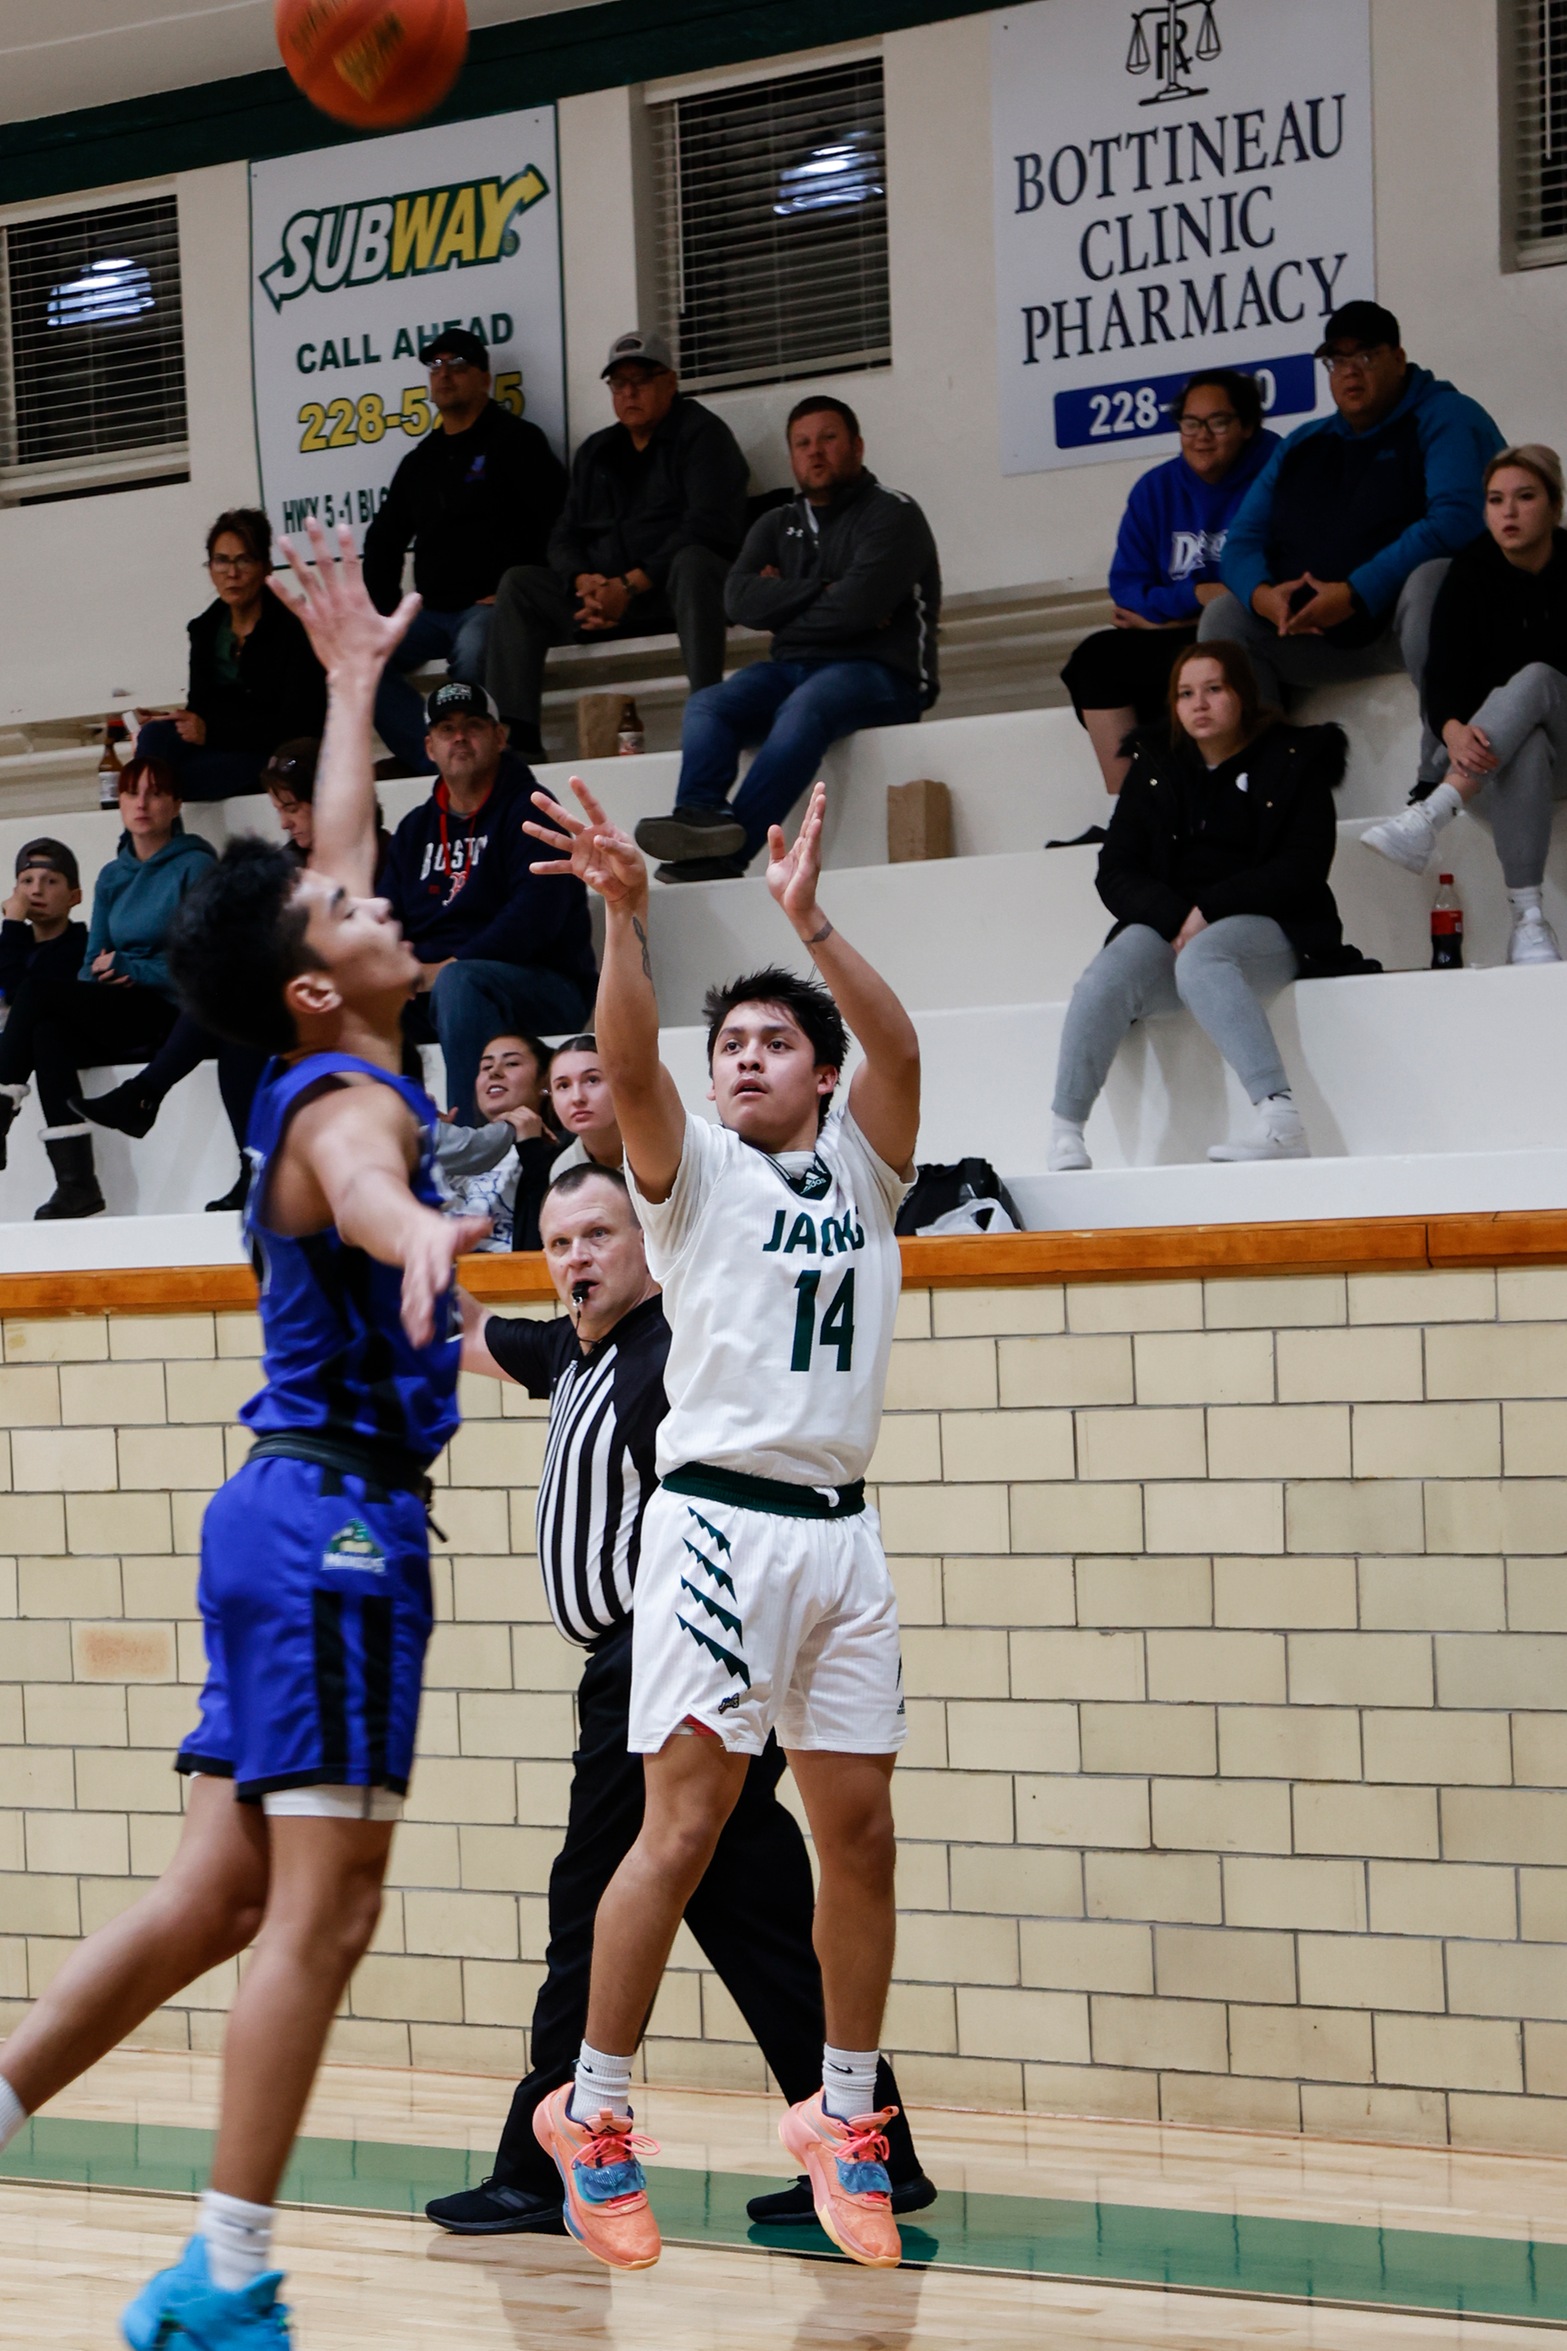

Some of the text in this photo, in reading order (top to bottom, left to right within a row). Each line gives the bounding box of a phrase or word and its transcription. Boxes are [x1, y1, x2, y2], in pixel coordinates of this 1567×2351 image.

[1013, 93, 1346, 214] BOTTINEAU
[259, 163, 550, 314] SUBWAY
[1079, 186, 1275, 282] CLINIC
[296, 312, 514, 374] CALL AHAD
[1021, 253, 1348, 365] PHARMACY
[790, 1267, 855, 1372] 14
